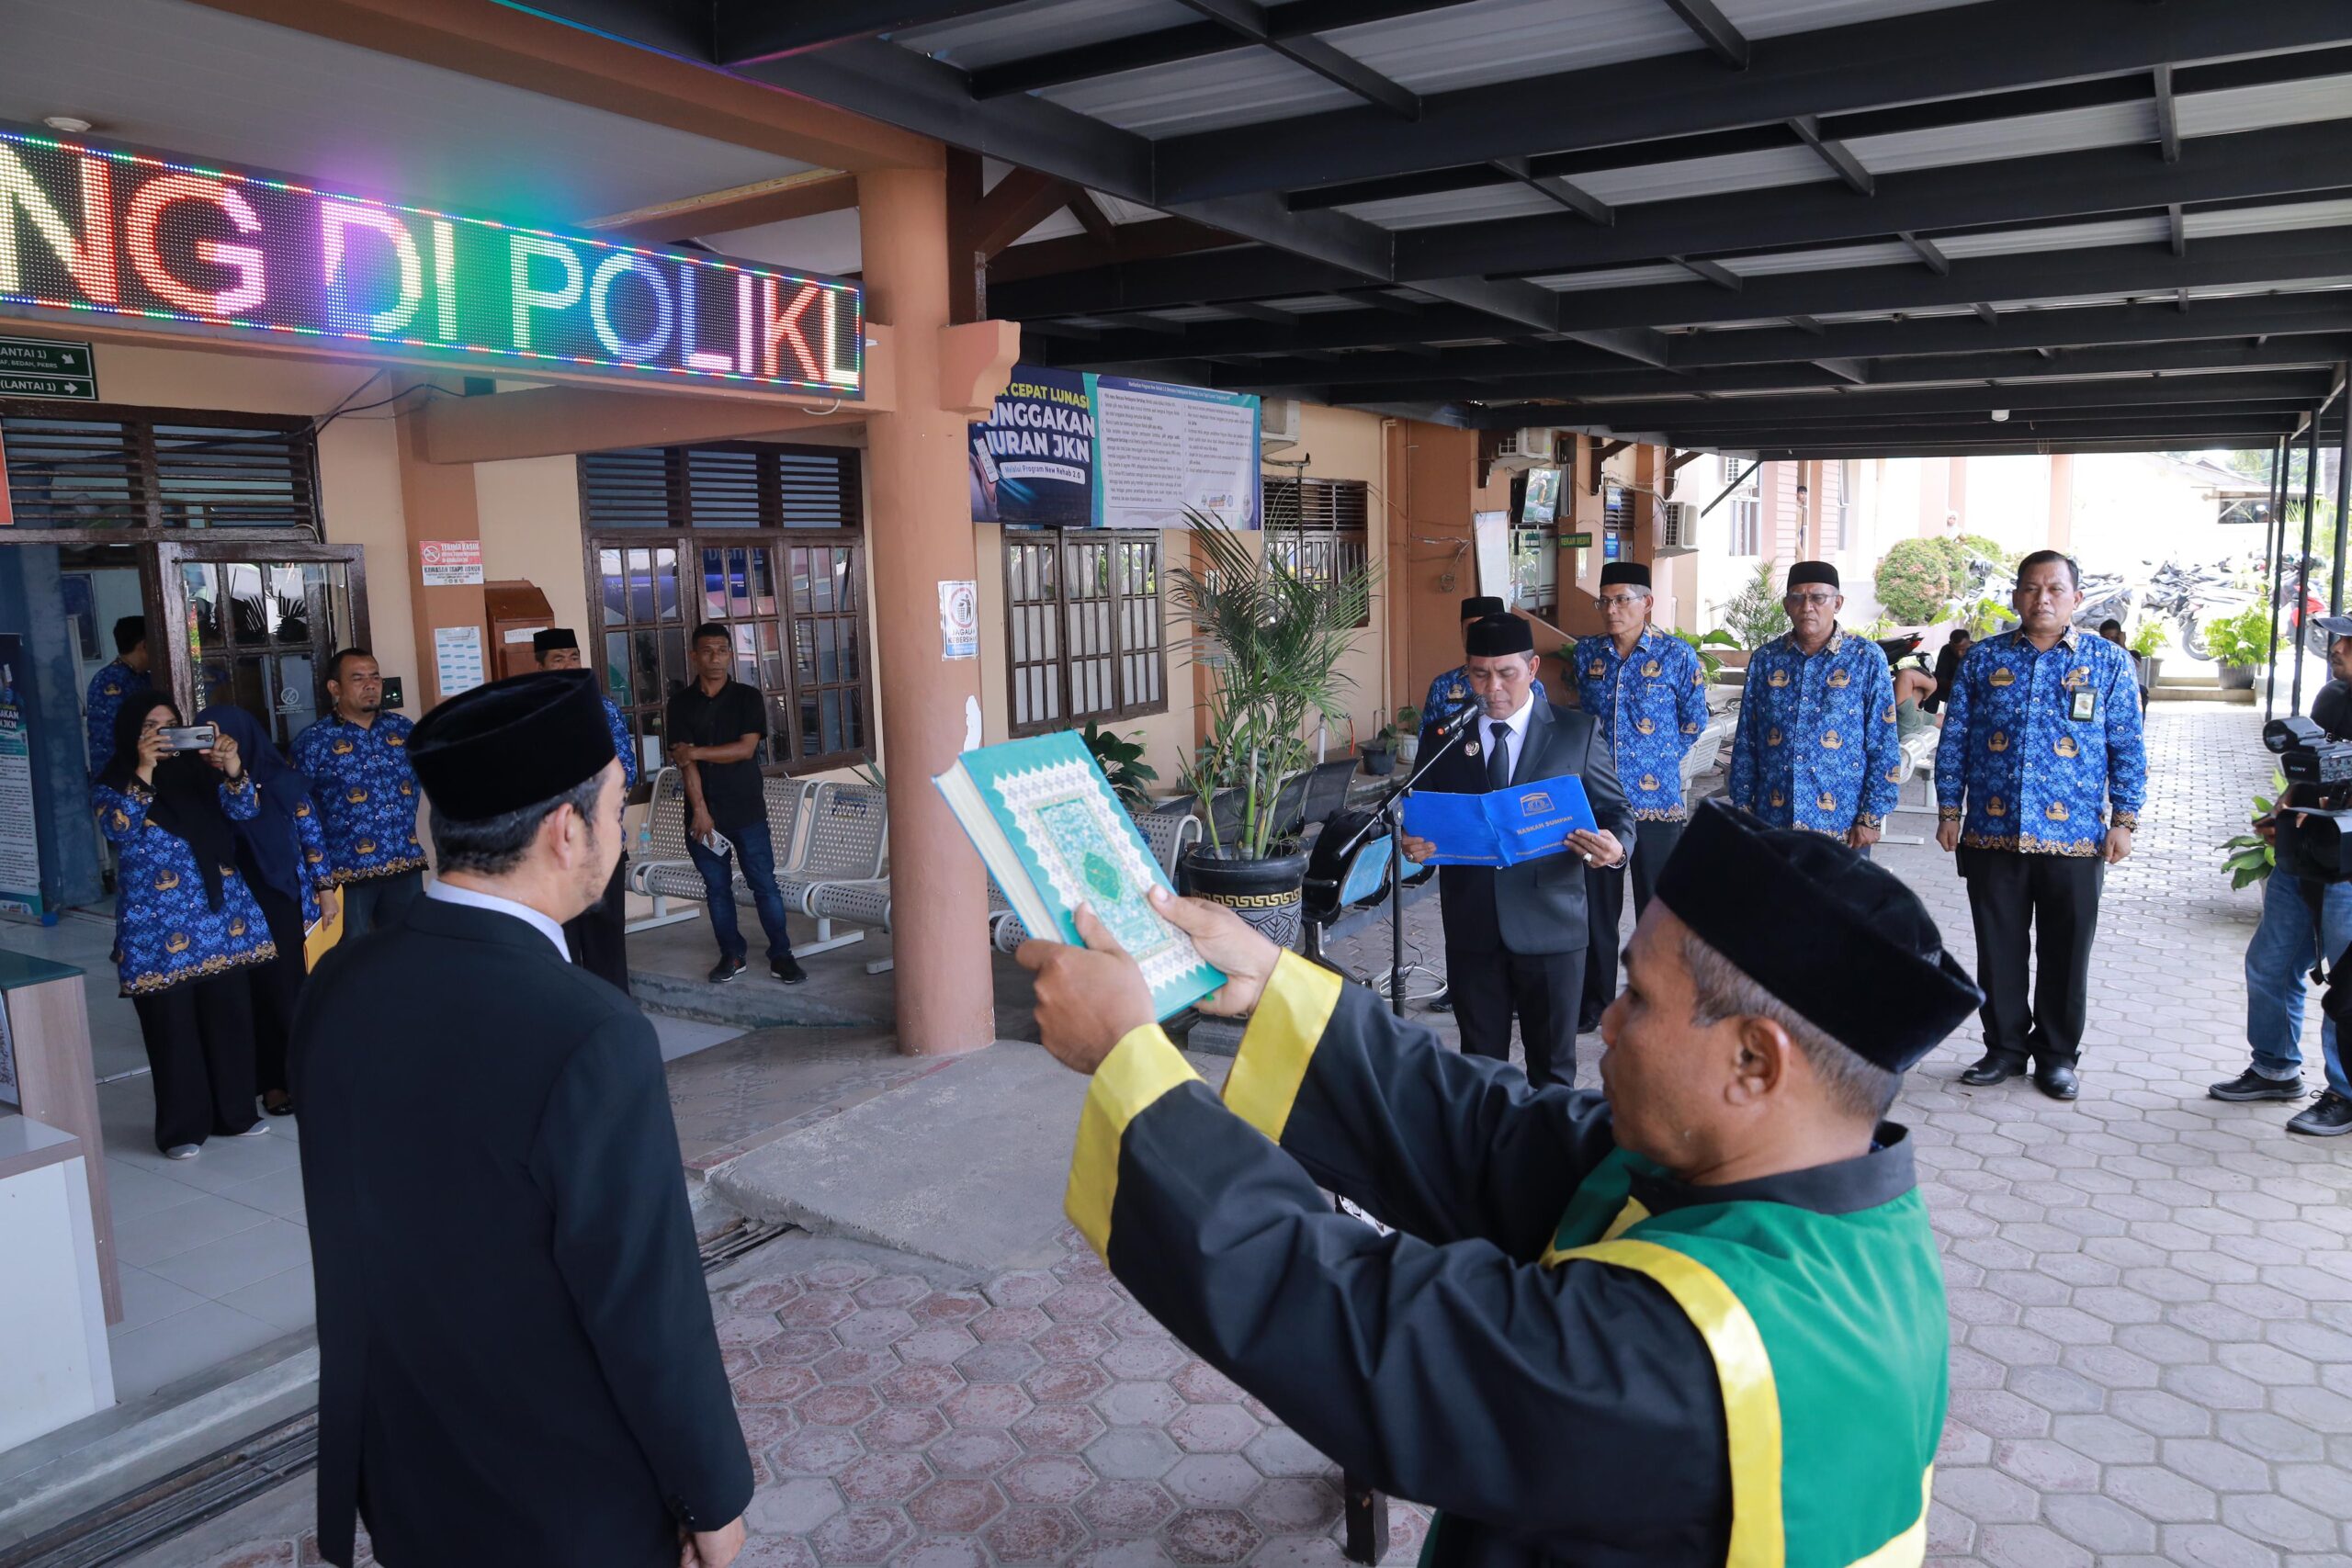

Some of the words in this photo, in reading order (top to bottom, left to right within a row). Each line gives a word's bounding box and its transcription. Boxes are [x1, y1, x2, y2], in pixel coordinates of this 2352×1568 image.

[320, 200, 457, 341] DI
[510, 234, 860, 384] POLIKL
[37, 350, 47, 359] 1)
[1, 379, 44, 391] (LANTAI
[47, 382, 56, 392] 1)
[1011, 382, 1048, 400] CEPAT
[1050, 387, 1091, 410] LUNASI
[977, 401, 1096, 438] UNGGAKAN
[985, 430, 1049, 457] IURAN
[1052, 434, 1091, 463] JKN
[1022, 465, 1045, 475] Program
[1045, 466, 1056, 474] New
[1056, 467, 1072, 478] Rehab
[1072, 470, 1081, 479] 2.0
